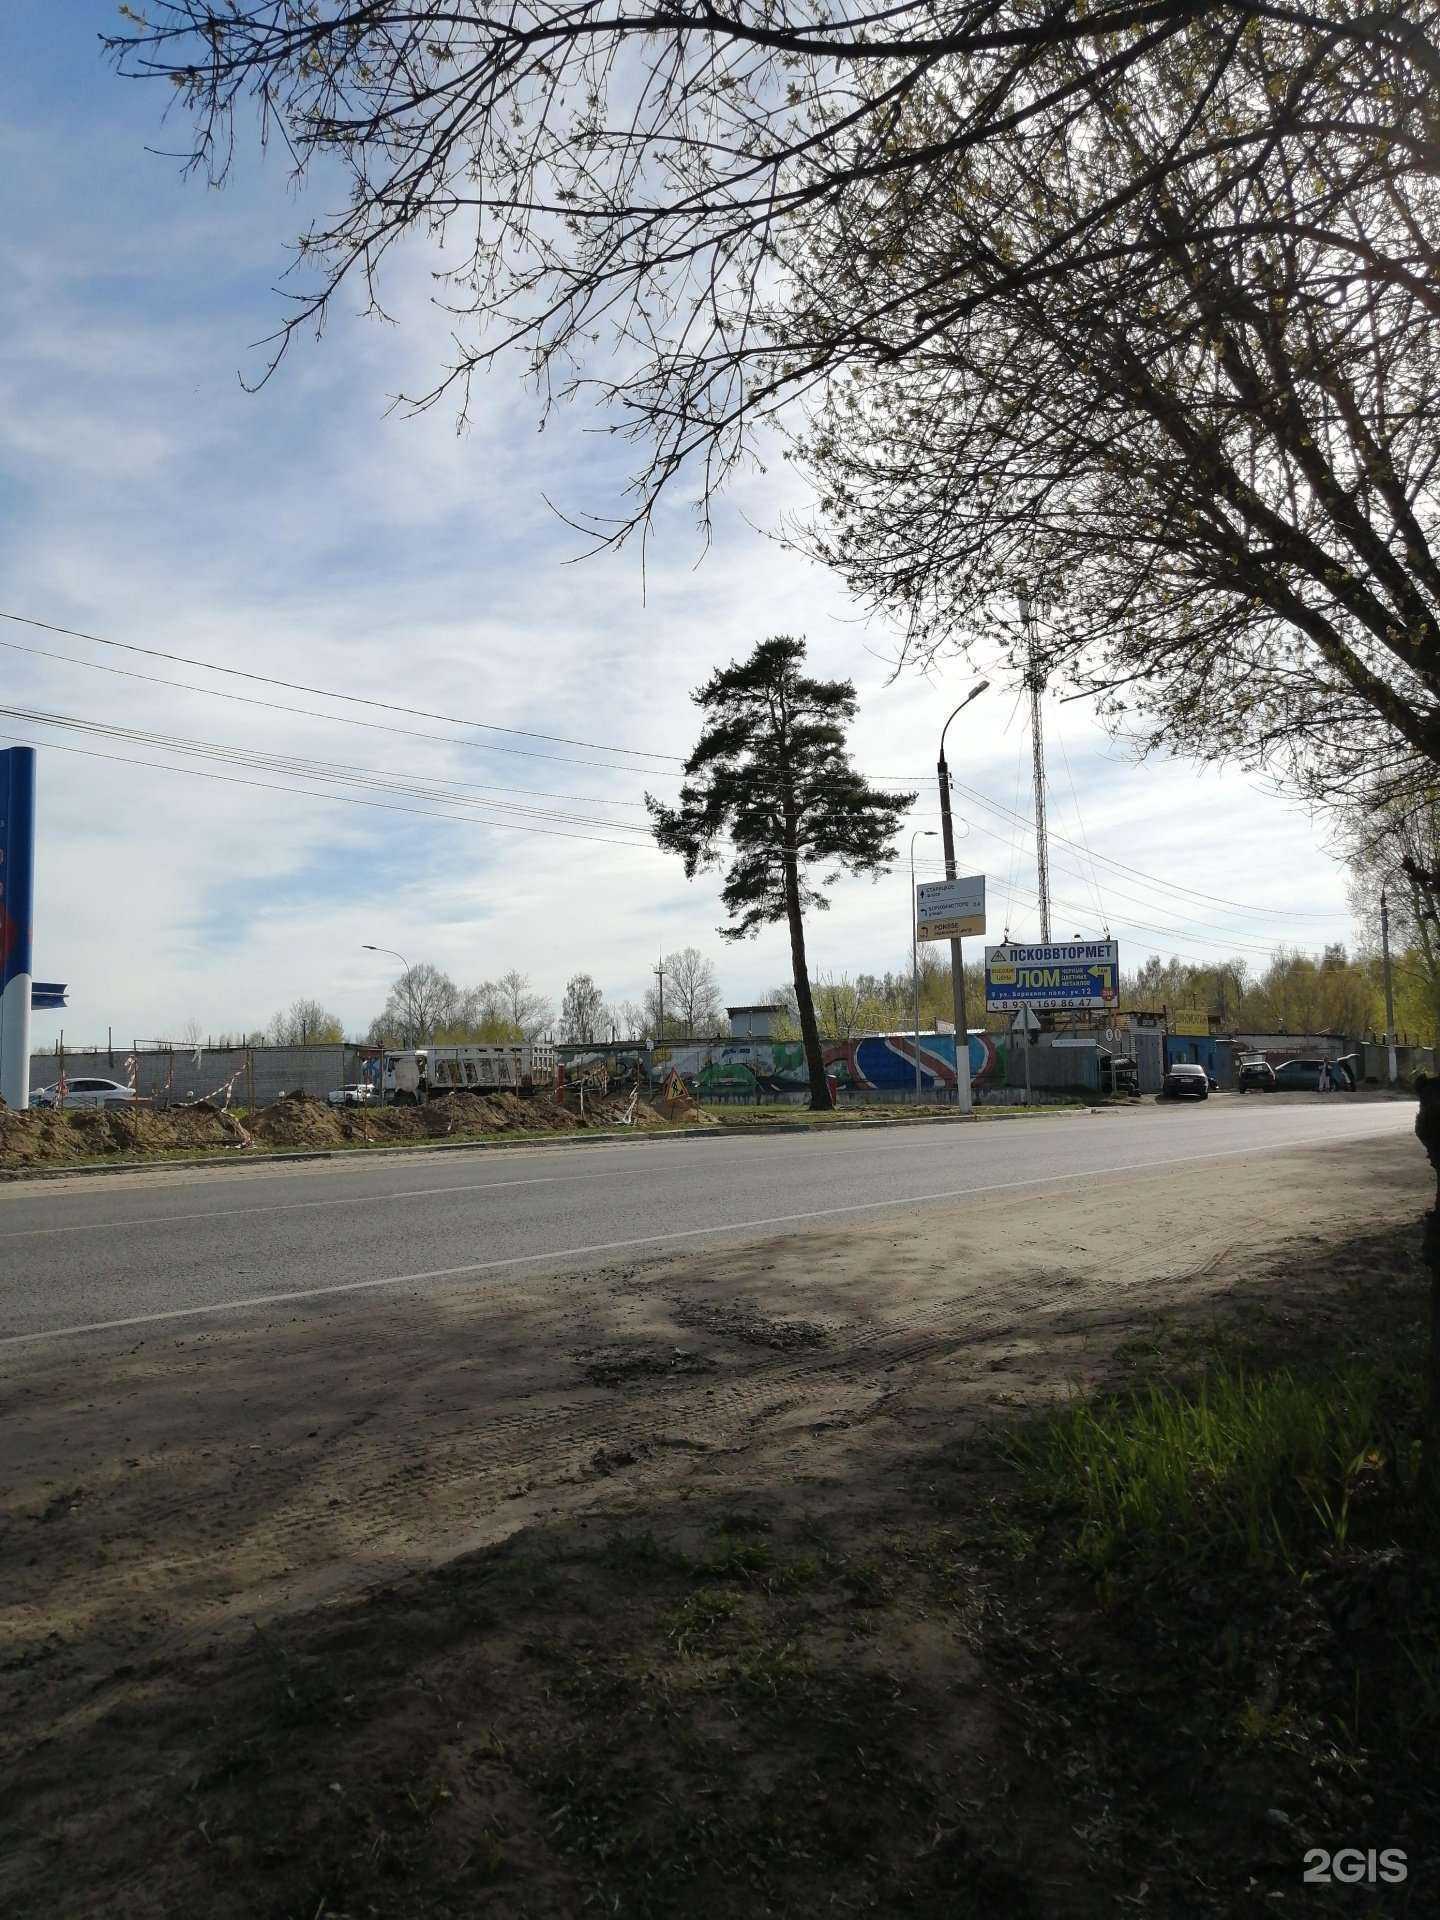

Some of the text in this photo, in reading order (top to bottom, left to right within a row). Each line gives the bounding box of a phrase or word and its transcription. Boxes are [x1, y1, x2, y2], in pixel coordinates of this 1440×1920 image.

[1009, 945, 1112, 962] ПСКОВВТОРМЕТ
[1016, 968, 1060, 989] ЛОМ
[1037, 999, 1056, 1008] 169
[1079, 998, 1092, 1007] 47
